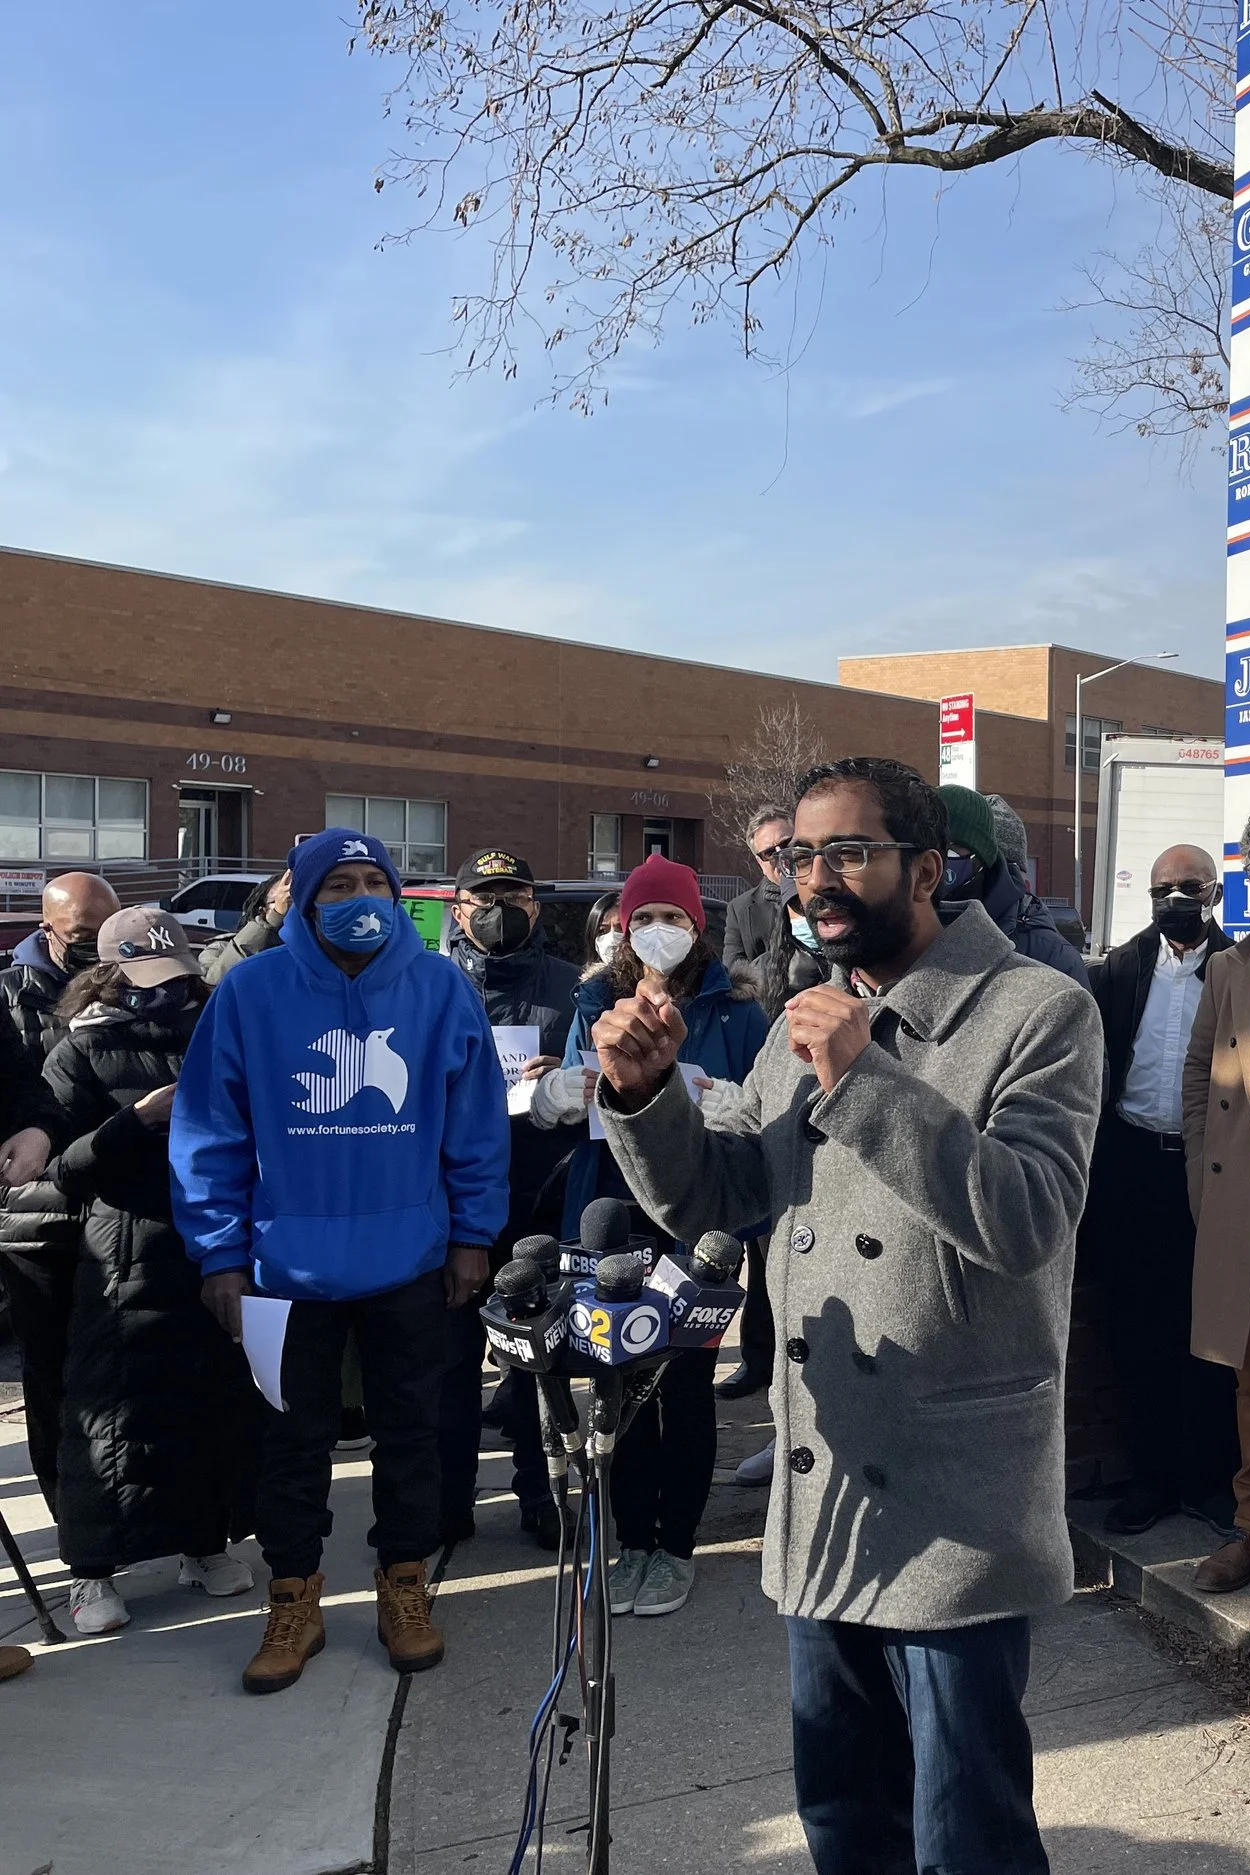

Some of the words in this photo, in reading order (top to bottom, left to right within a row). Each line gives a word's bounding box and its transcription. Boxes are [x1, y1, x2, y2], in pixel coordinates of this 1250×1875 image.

[186, 752, 247, 774] 49-08
[477, 852, 496, 865] GULF
[497, 852, 515, 865] WAR
[501, 1053, 527, 1063] AND
[287, 1123, 416, 1135] www.fortunesociety.org
[590, 1308, 611, 1348] 2
[487, 1332, 518, 1355] NEWS
[568, 1334, 611, 1362] NEWS
